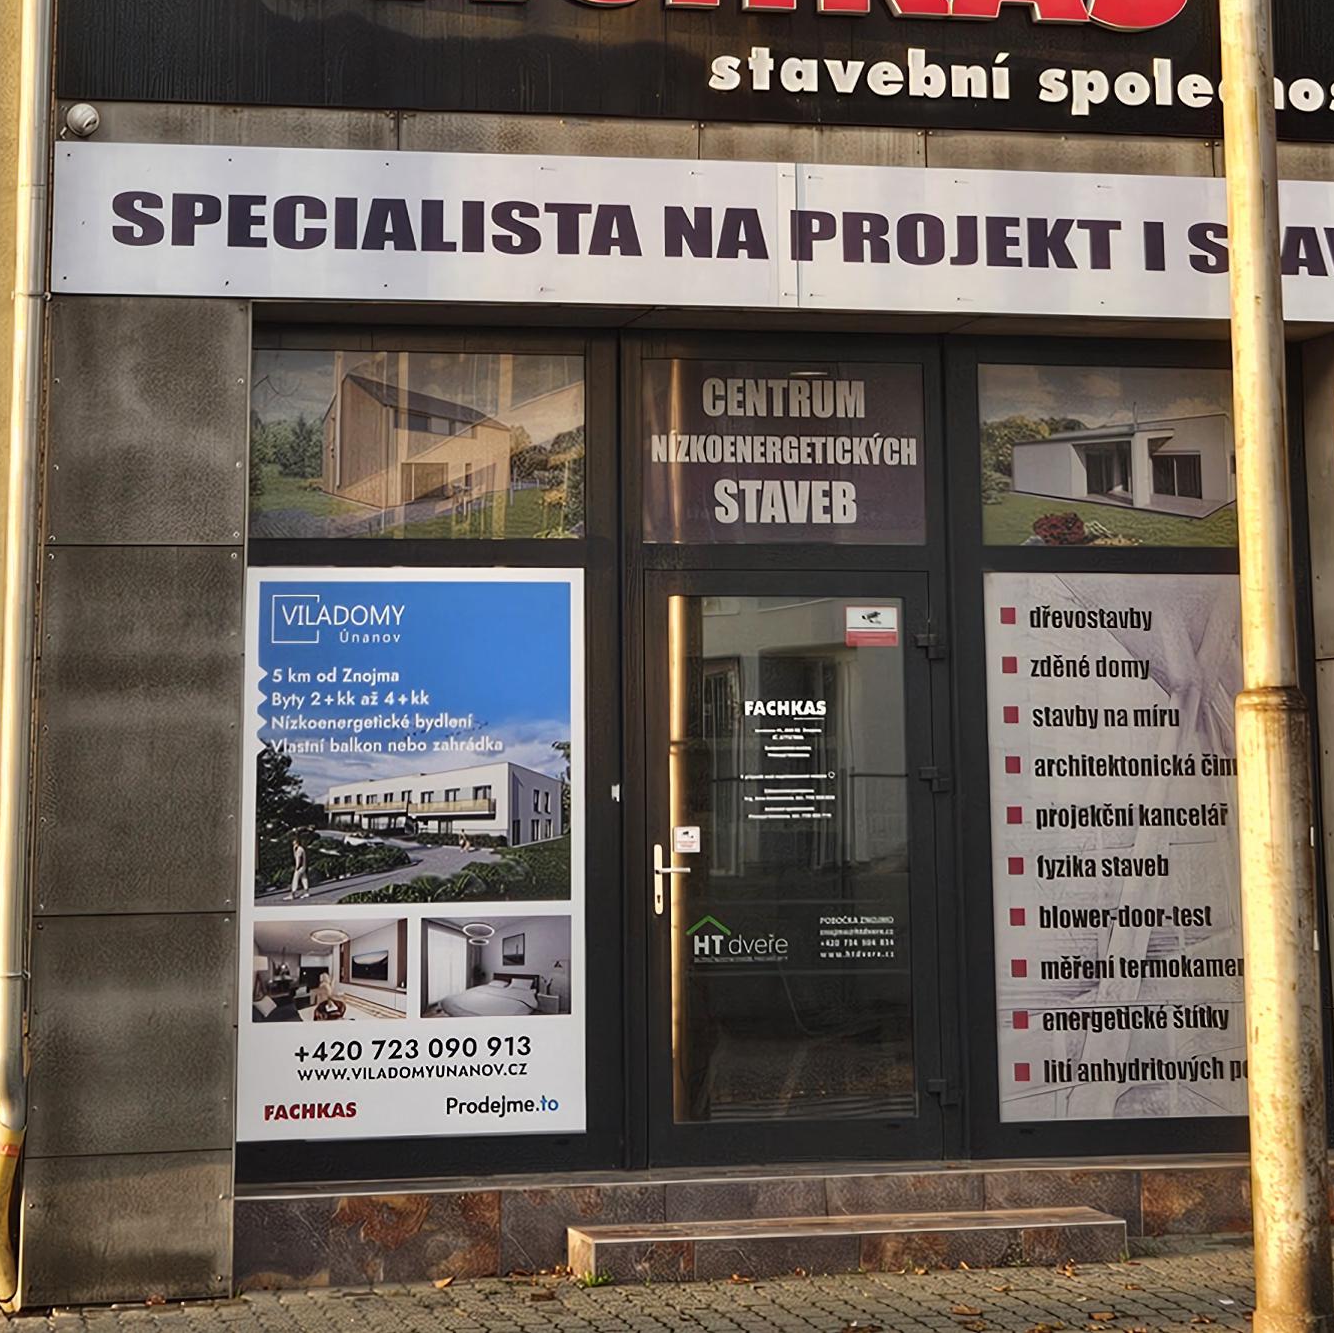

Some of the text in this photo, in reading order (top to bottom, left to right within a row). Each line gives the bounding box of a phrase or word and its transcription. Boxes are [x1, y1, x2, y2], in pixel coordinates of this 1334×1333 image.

[707, 47, 1011, 100] stavební
[111, 191, 643, 257] SPECIALISTA
[664, 206, 769, 261] NA
[790, 209, 1122, 271] PROJEKT
[1144, 221, 1165, 272] I
[702, 377, 866, 420] CENTRUM
[651, 431, 917, 466] NÍZKOENERGETICKÝCH
[714, 479, 858, 525] STAVEB
[281, 604, 405, 626] VILADOMY
[1029, 606, 1153, 632] dřevostavby
[339, 628, 401, 644] Únanov
[271, 668, 400, 686] 5 km od Znojma
[1030, 655, 1150, 680] zděné domy
[271, 692, 305, 710] Byty
[361, 690, 378, 706] až
[745, 700, 826, 715] FACHKAS
[271, 713, 472, 733] Nízkoenergetické bydlení
[1032, 704, 1180, 730] stavby na míru
[271, 736, 504, 754] Vlastní balkon nebo zahrádka
[1034, 753, 1195, 777] architektonická
[1035, 802, 1229, 830] projekční kancelář
[1037, 854, 1169, 880] fyzika staveb
[1039, 904, 1212, 929] blower-door-test
[693, 933, 789, 955] HT dveře
[1040, 955, 1115, 980] měření
[1042, 1005, 1229, 1033] energetické štítky
[295, 1036, 532, 1063] +420 723 090 913
[297, 1062, 529, 1081] WWW.VILADOMYUNANOV.CZ
[1044, 1057, 1074, 1083] lití
[1078, 1055, 1224, 1085] anhydritových
[264, 1095, 559, 1121] FACHKAS Prodejme.to
